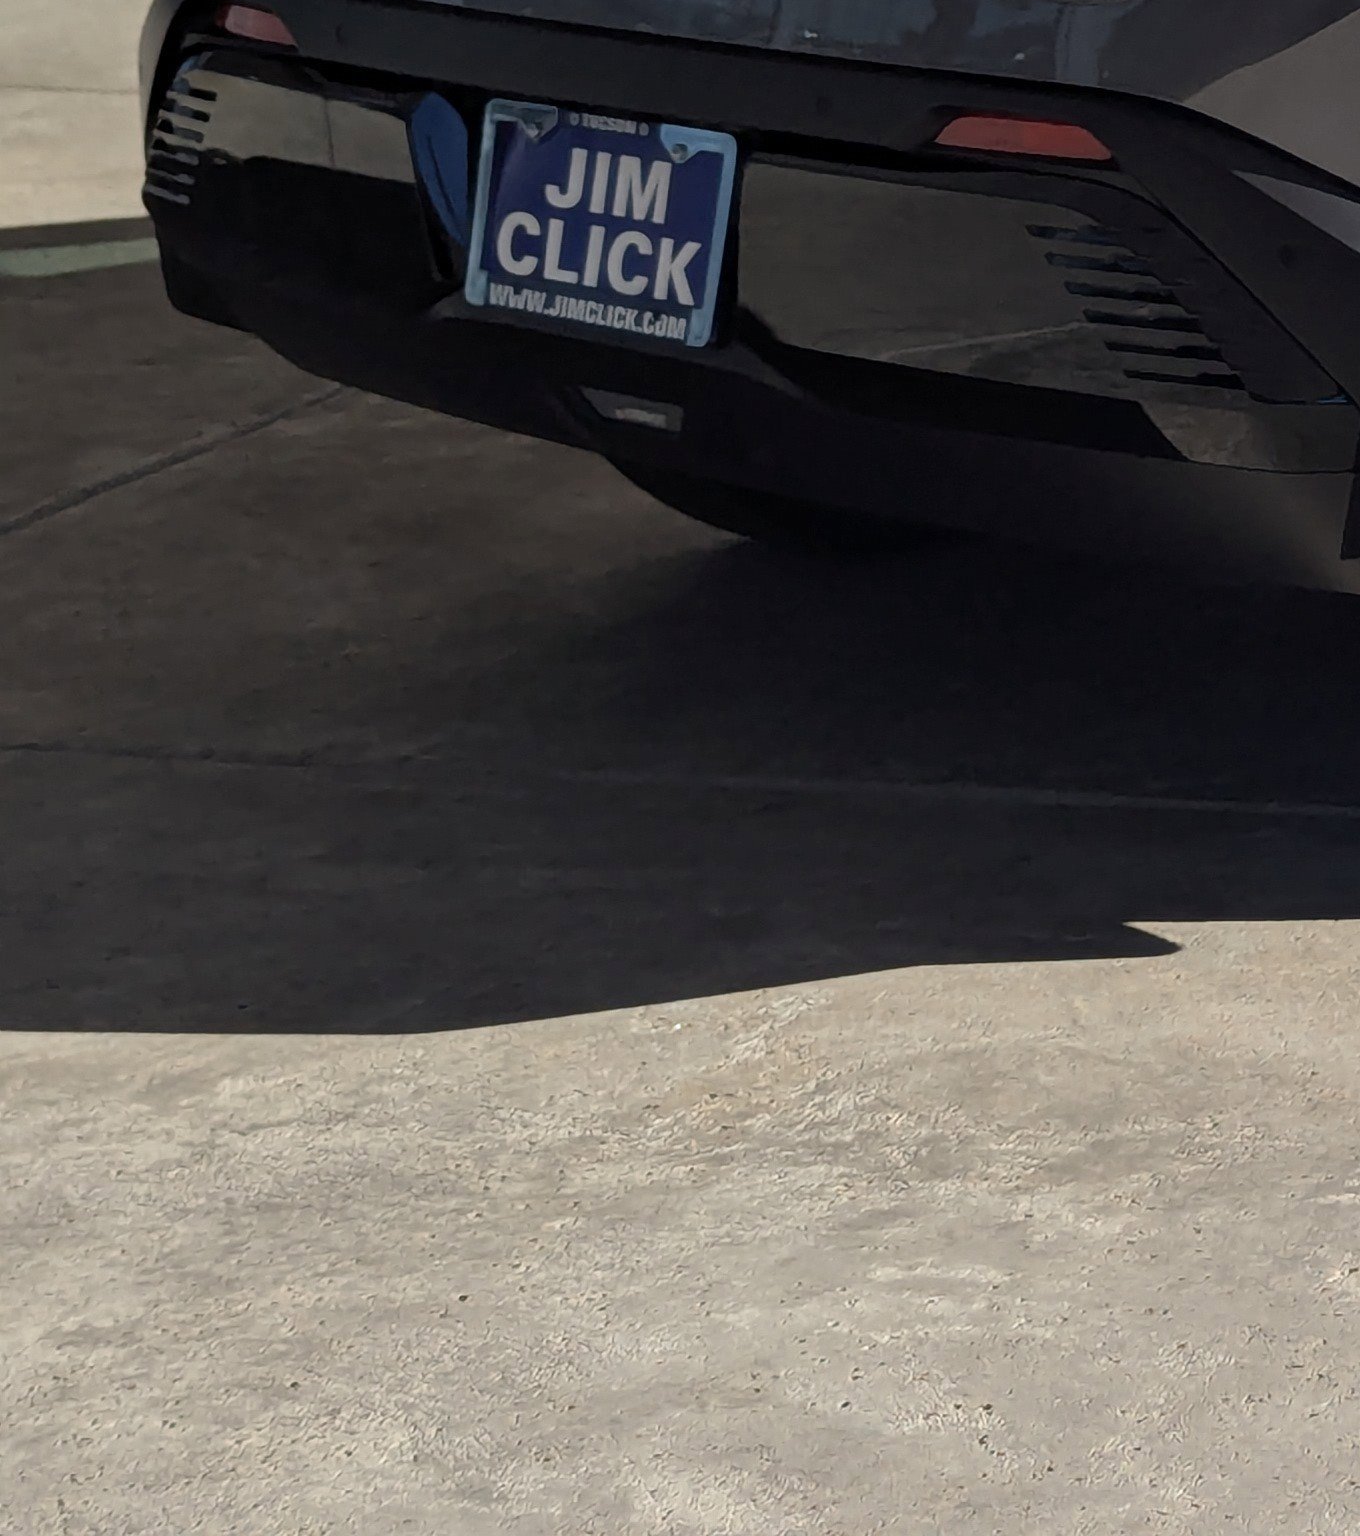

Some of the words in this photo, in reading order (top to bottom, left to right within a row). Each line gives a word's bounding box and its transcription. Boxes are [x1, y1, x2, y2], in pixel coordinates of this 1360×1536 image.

[544, 147, 672, 225] JIM
[496, 211, 702, 306] CLICK
[489, 282, 687, 340] WWW.JIMCLICK.COM
